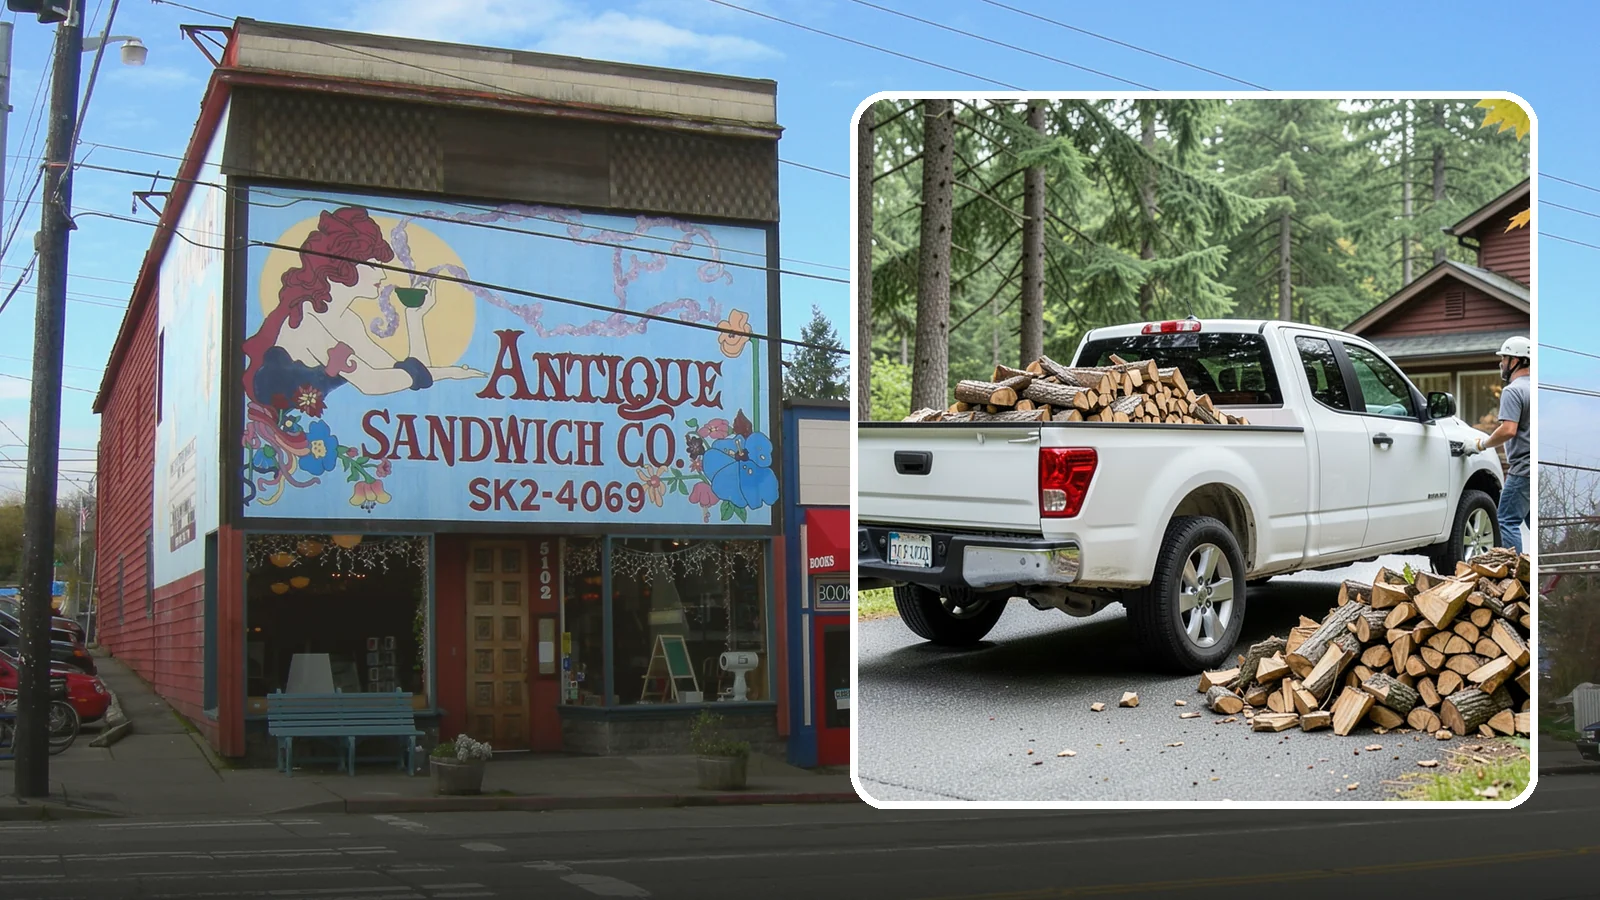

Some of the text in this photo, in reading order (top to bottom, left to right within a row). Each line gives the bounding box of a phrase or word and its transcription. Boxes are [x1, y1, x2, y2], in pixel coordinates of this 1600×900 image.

[477, 329, 723, 420] ANTIQUE
[361, 410, 685, 468] SANDWICH CO.
[469, 478, 645, 513] SK2-4069
[540, 542, 551, 599] 5102
[809, 555, 834, 568] BOOKS
